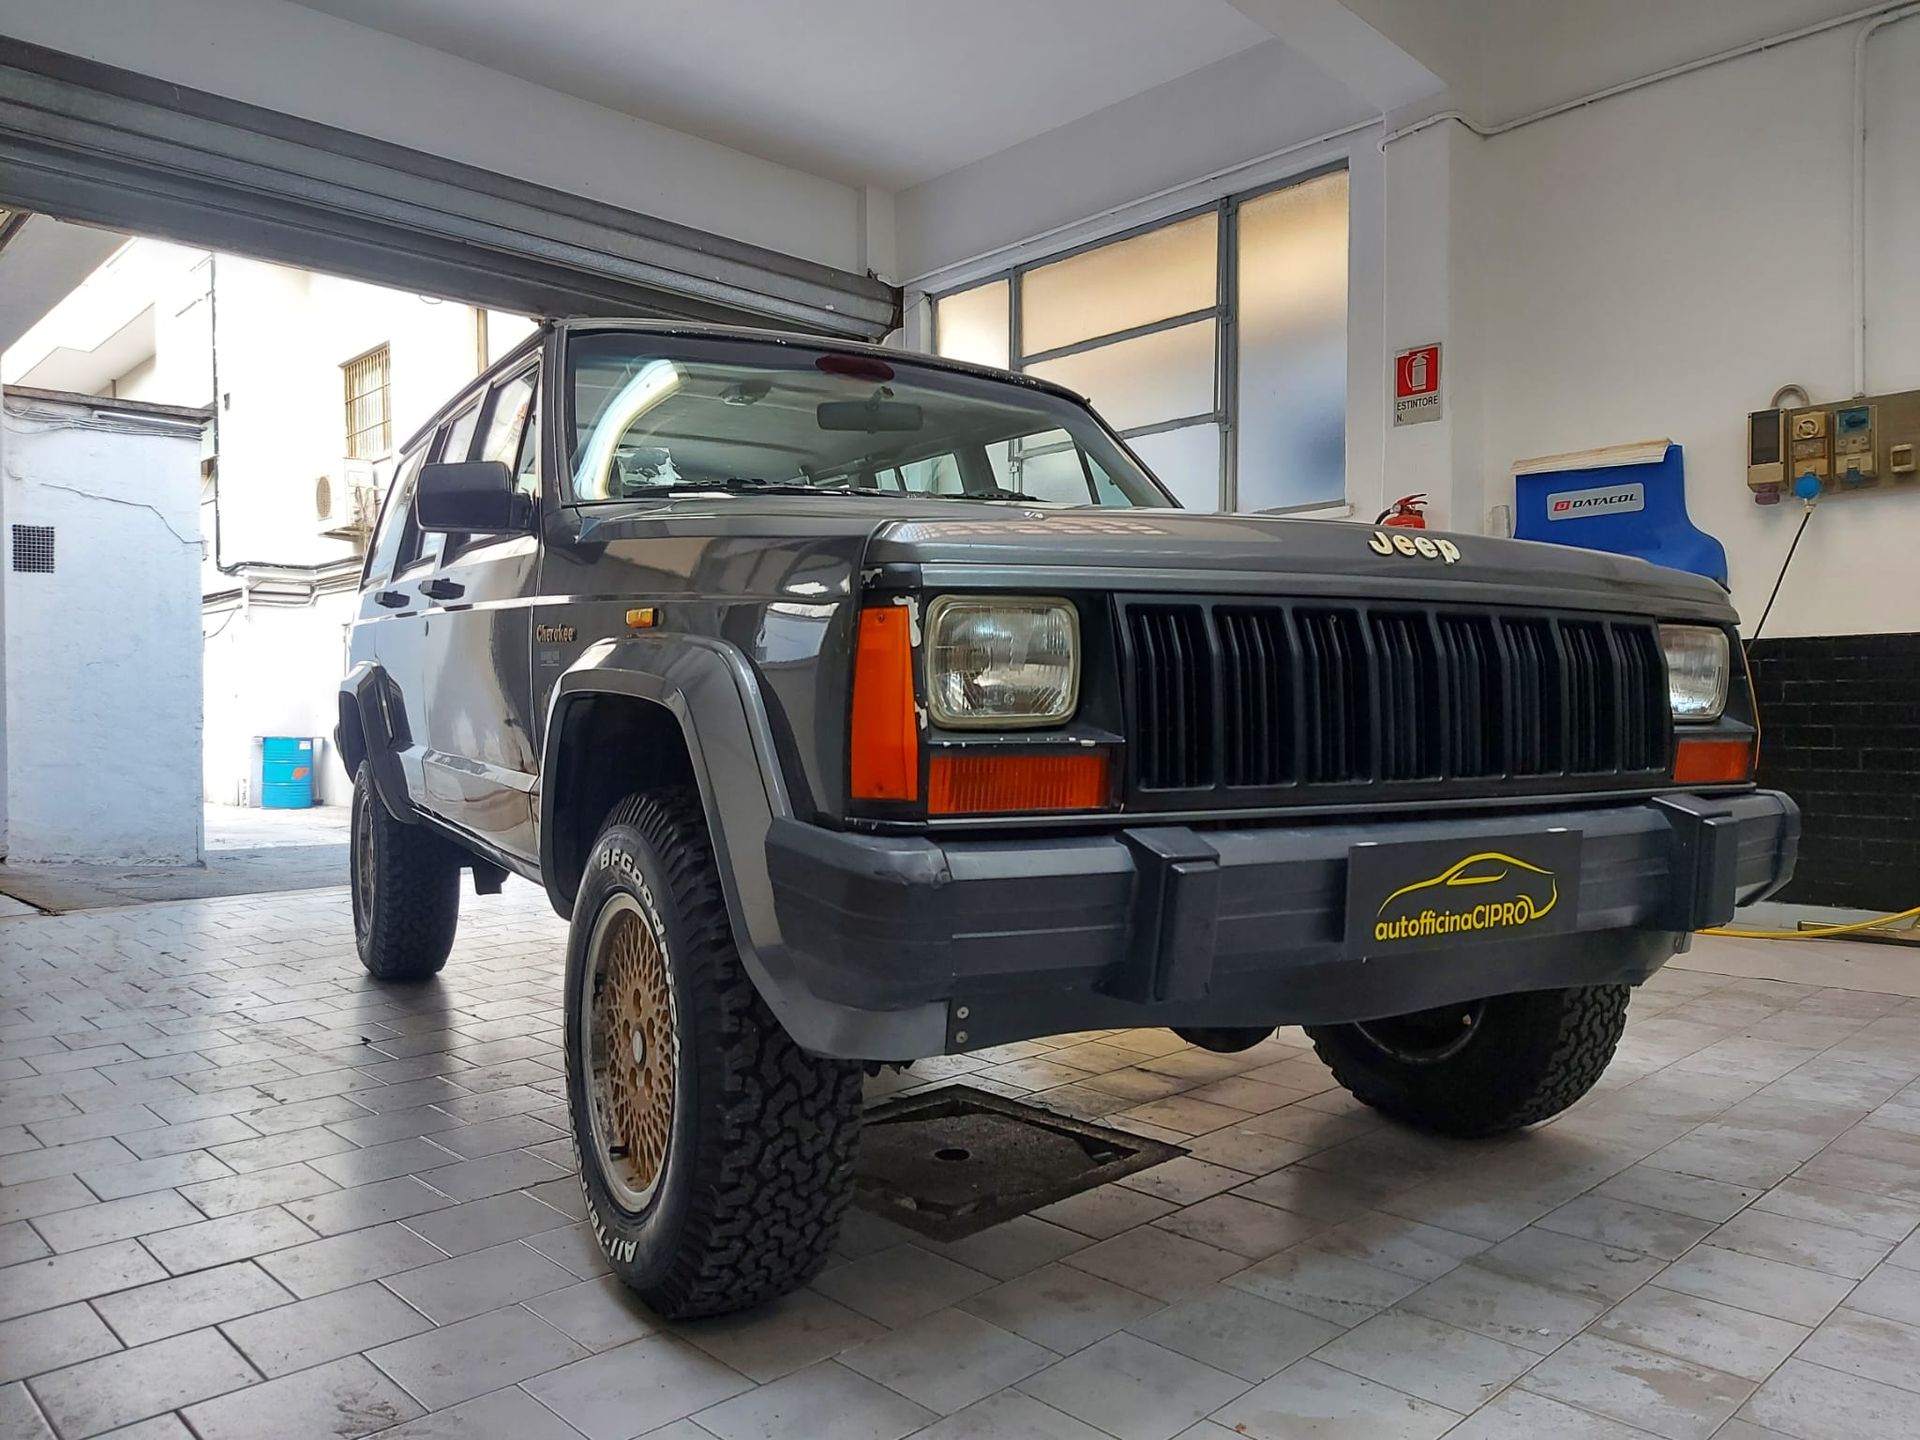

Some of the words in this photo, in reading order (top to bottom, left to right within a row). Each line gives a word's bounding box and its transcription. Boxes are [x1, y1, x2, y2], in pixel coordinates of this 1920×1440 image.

[1397, 396, 1439, 411] ESTINTORE
[1573, 494, 1638, 508] DATACOL
[1368, 531, 1461, 565] Jeep
[536, 624, 576, 642] Cherokee
